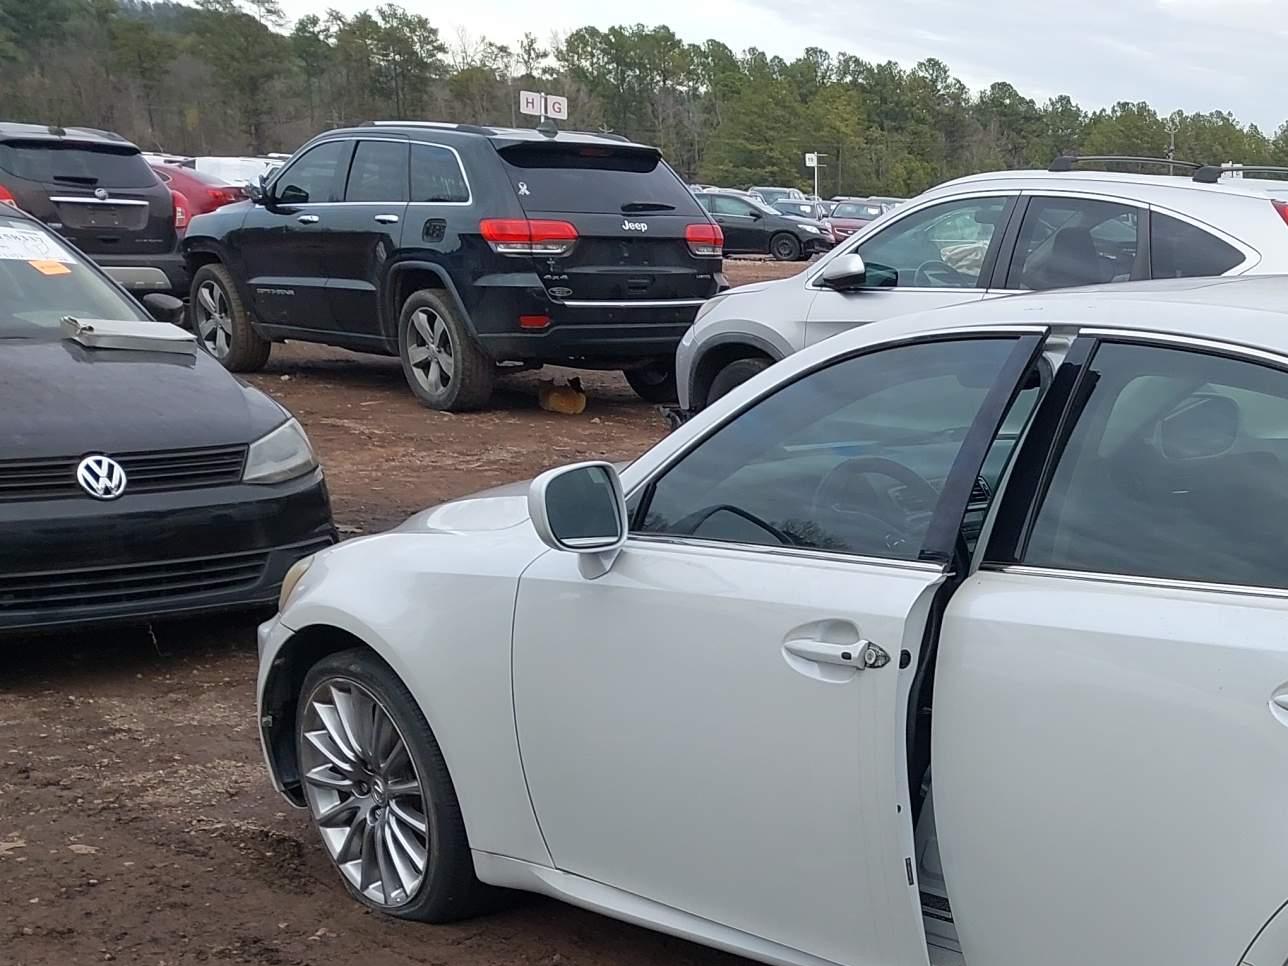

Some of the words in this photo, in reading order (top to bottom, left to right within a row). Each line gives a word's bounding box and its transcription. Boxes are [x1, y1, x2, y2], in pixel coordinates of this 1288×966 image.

[525, 97, 535, 109] H
[552, 101, 562, 114] G
[622, 220, 648, 232] Jeep
